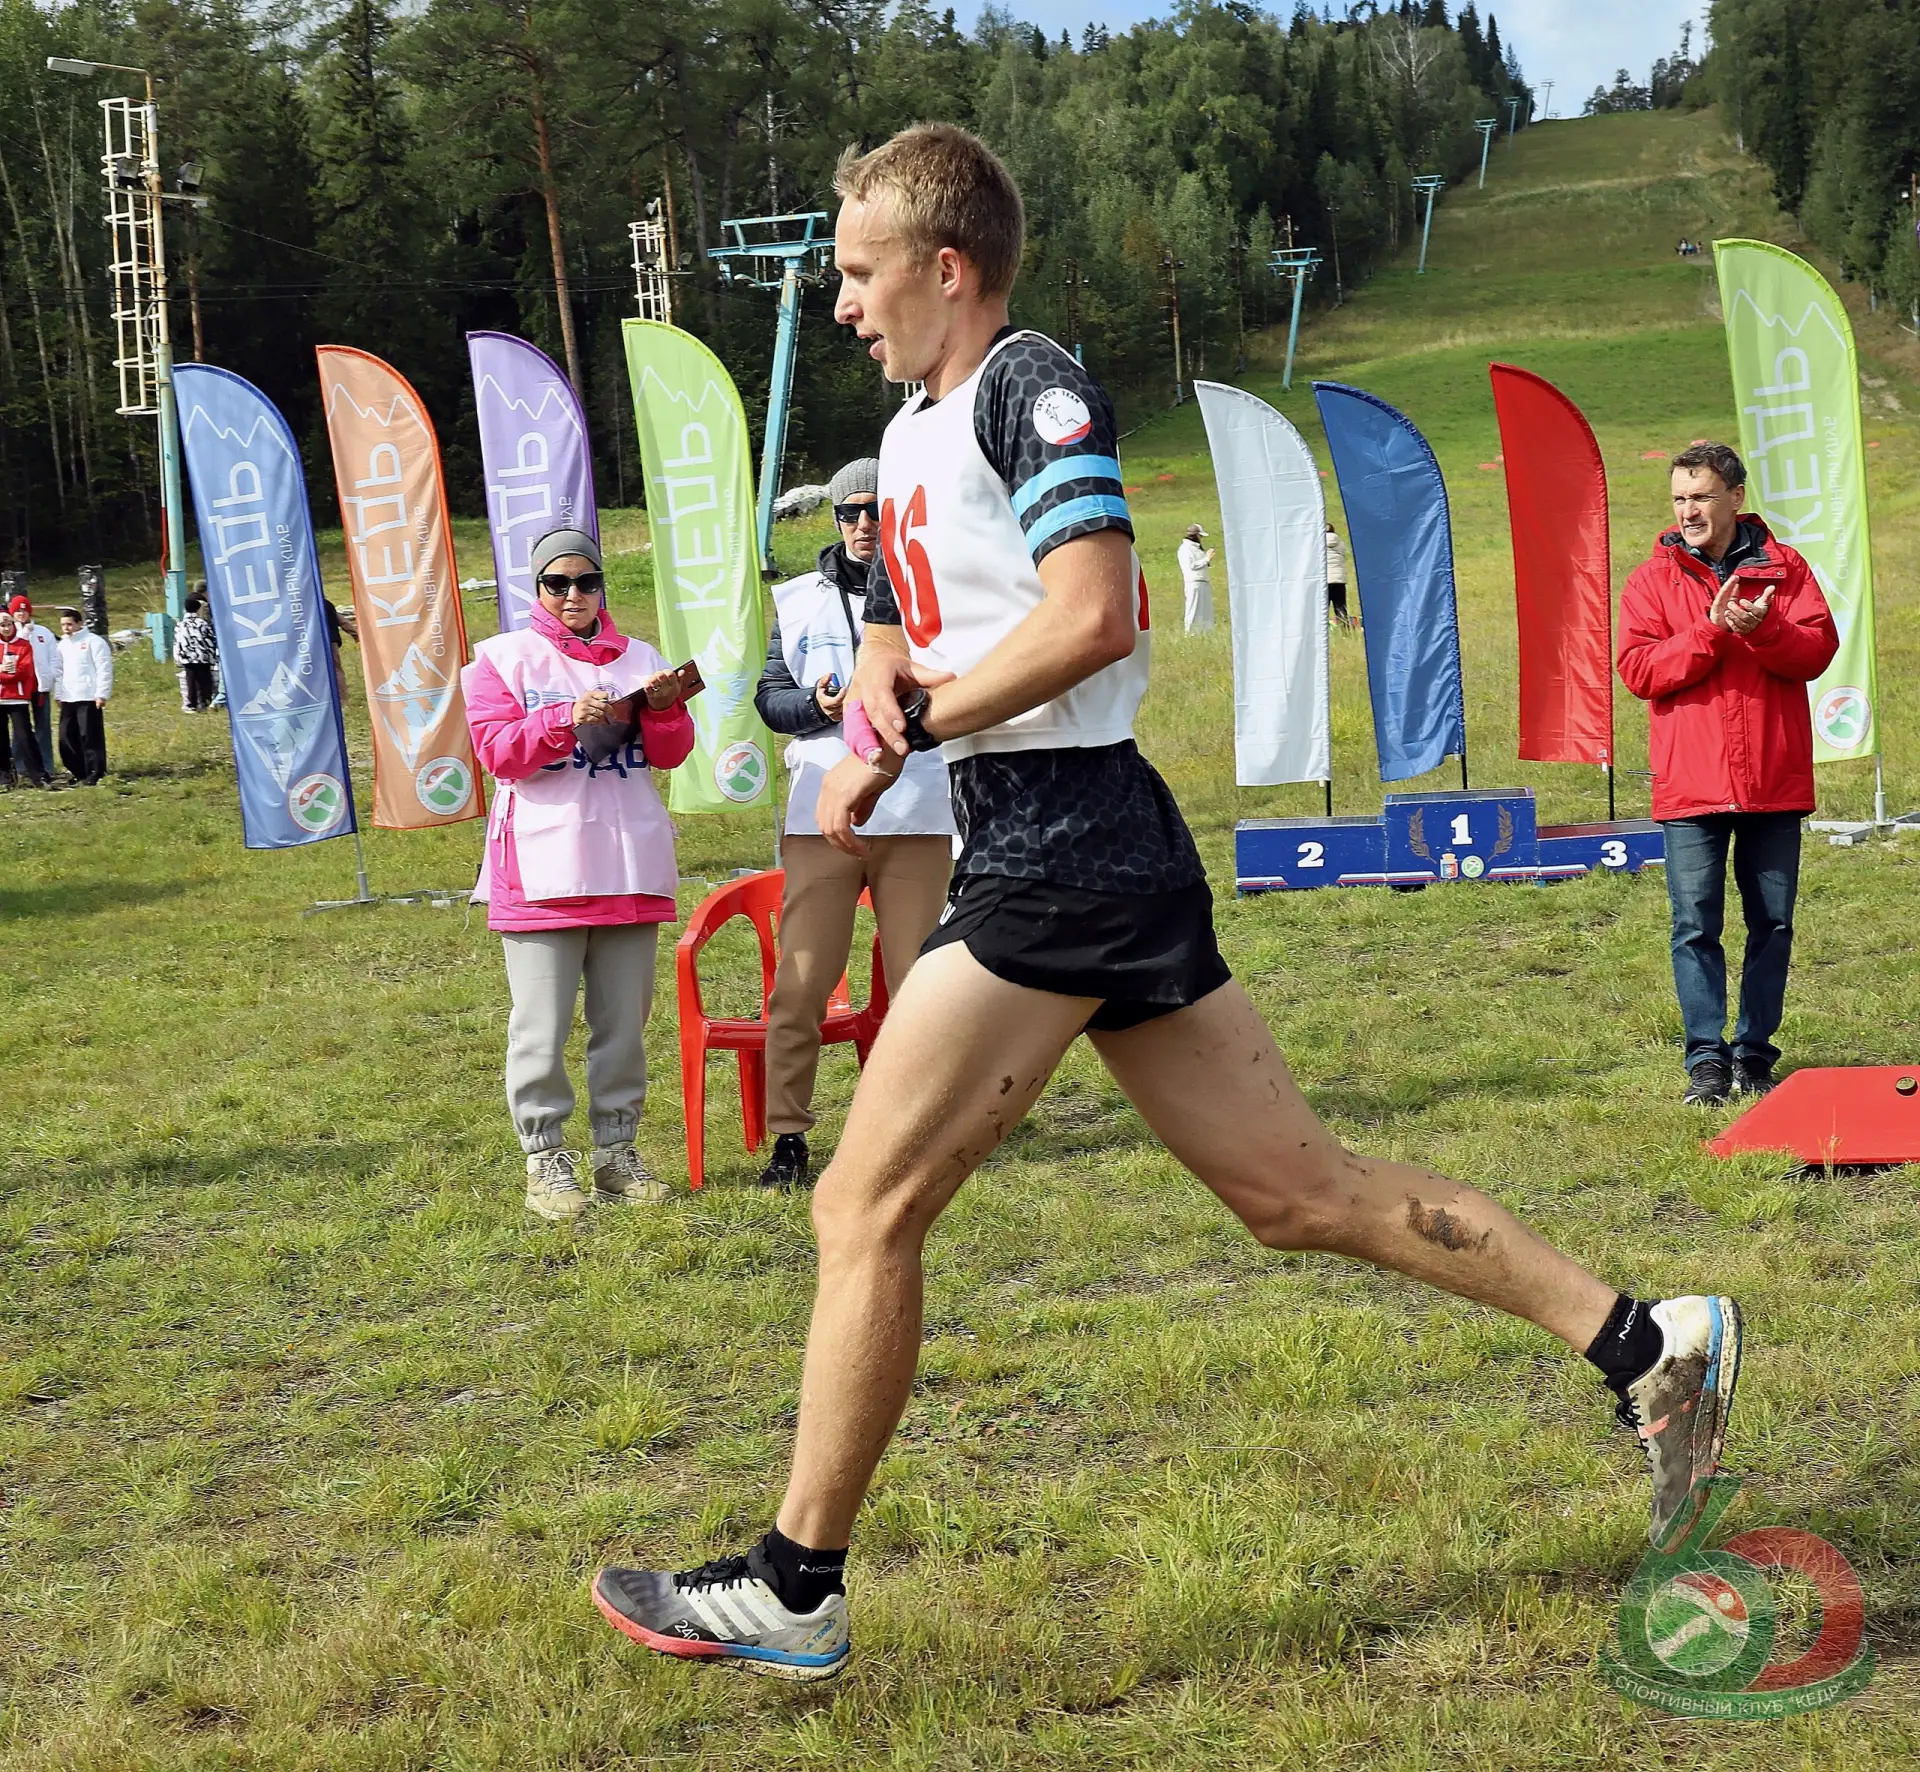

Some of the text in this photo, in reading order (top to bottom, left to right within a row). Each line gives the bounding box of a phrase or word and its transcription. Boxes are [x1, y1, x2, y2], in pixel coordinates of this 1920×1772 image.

[1449, 813, 1474, 846] 1
[1296, 841, 1326, 868] 2
[1599, 840, 1629, 868] 3
